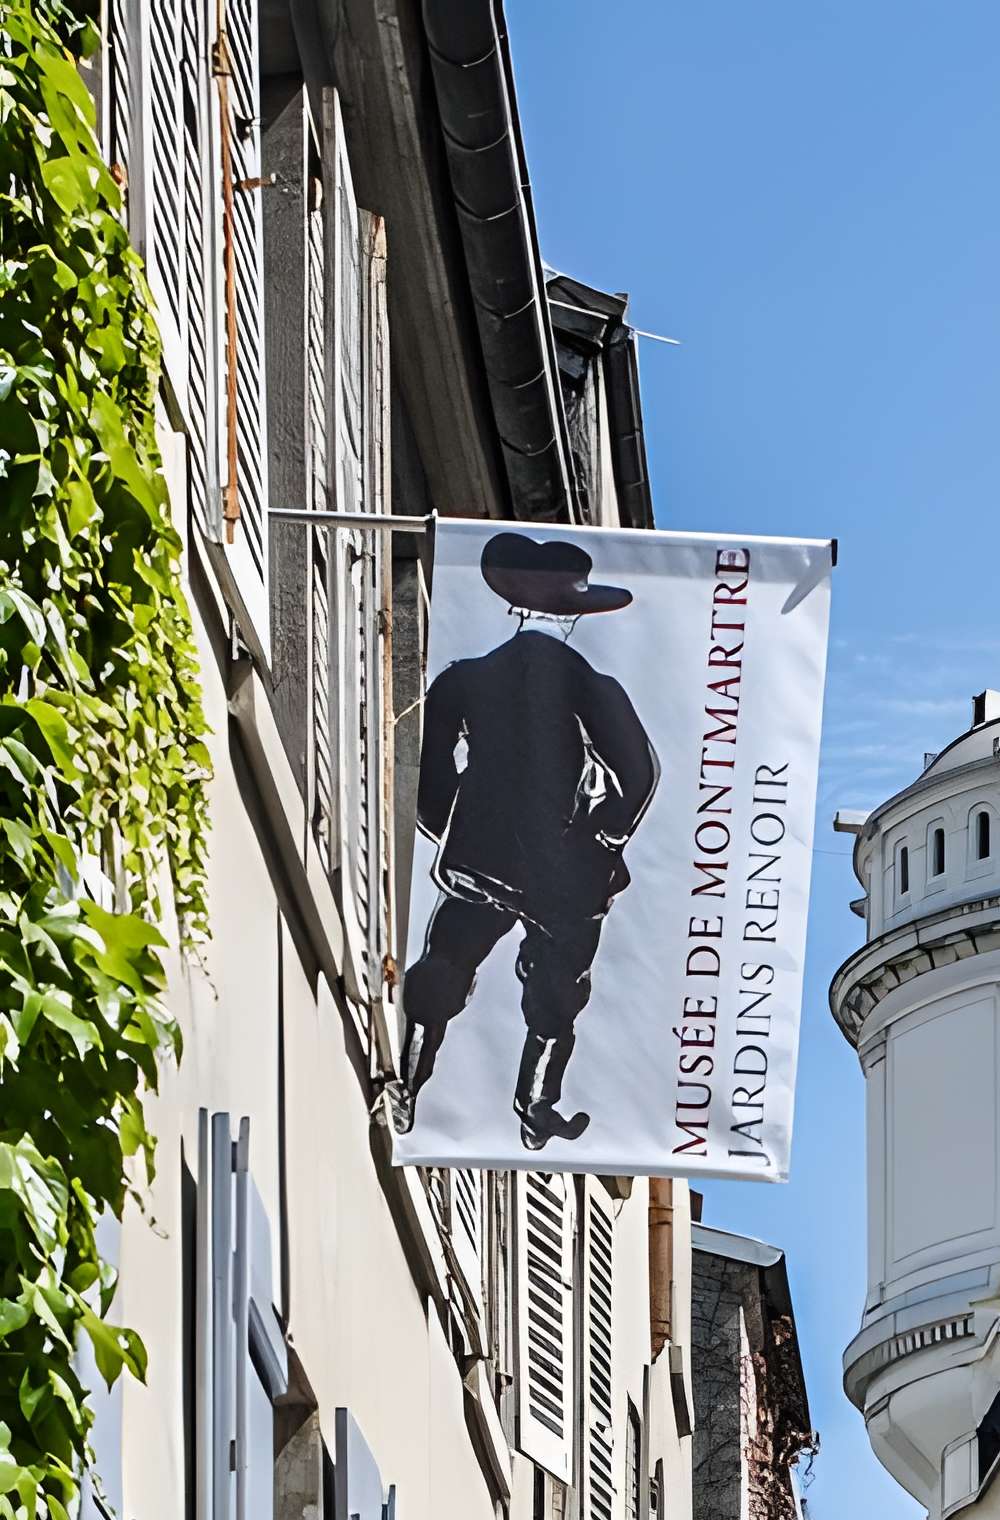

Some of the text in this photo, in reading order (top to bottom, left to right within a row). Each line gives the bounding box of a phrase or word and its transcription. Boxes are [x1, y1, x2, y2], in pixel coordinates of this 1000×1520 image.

[672, 548, 750, 1157] MUSÉE DE MONTMARTRE
[728, 762, 789, 1167] JARDINS RENOIR
